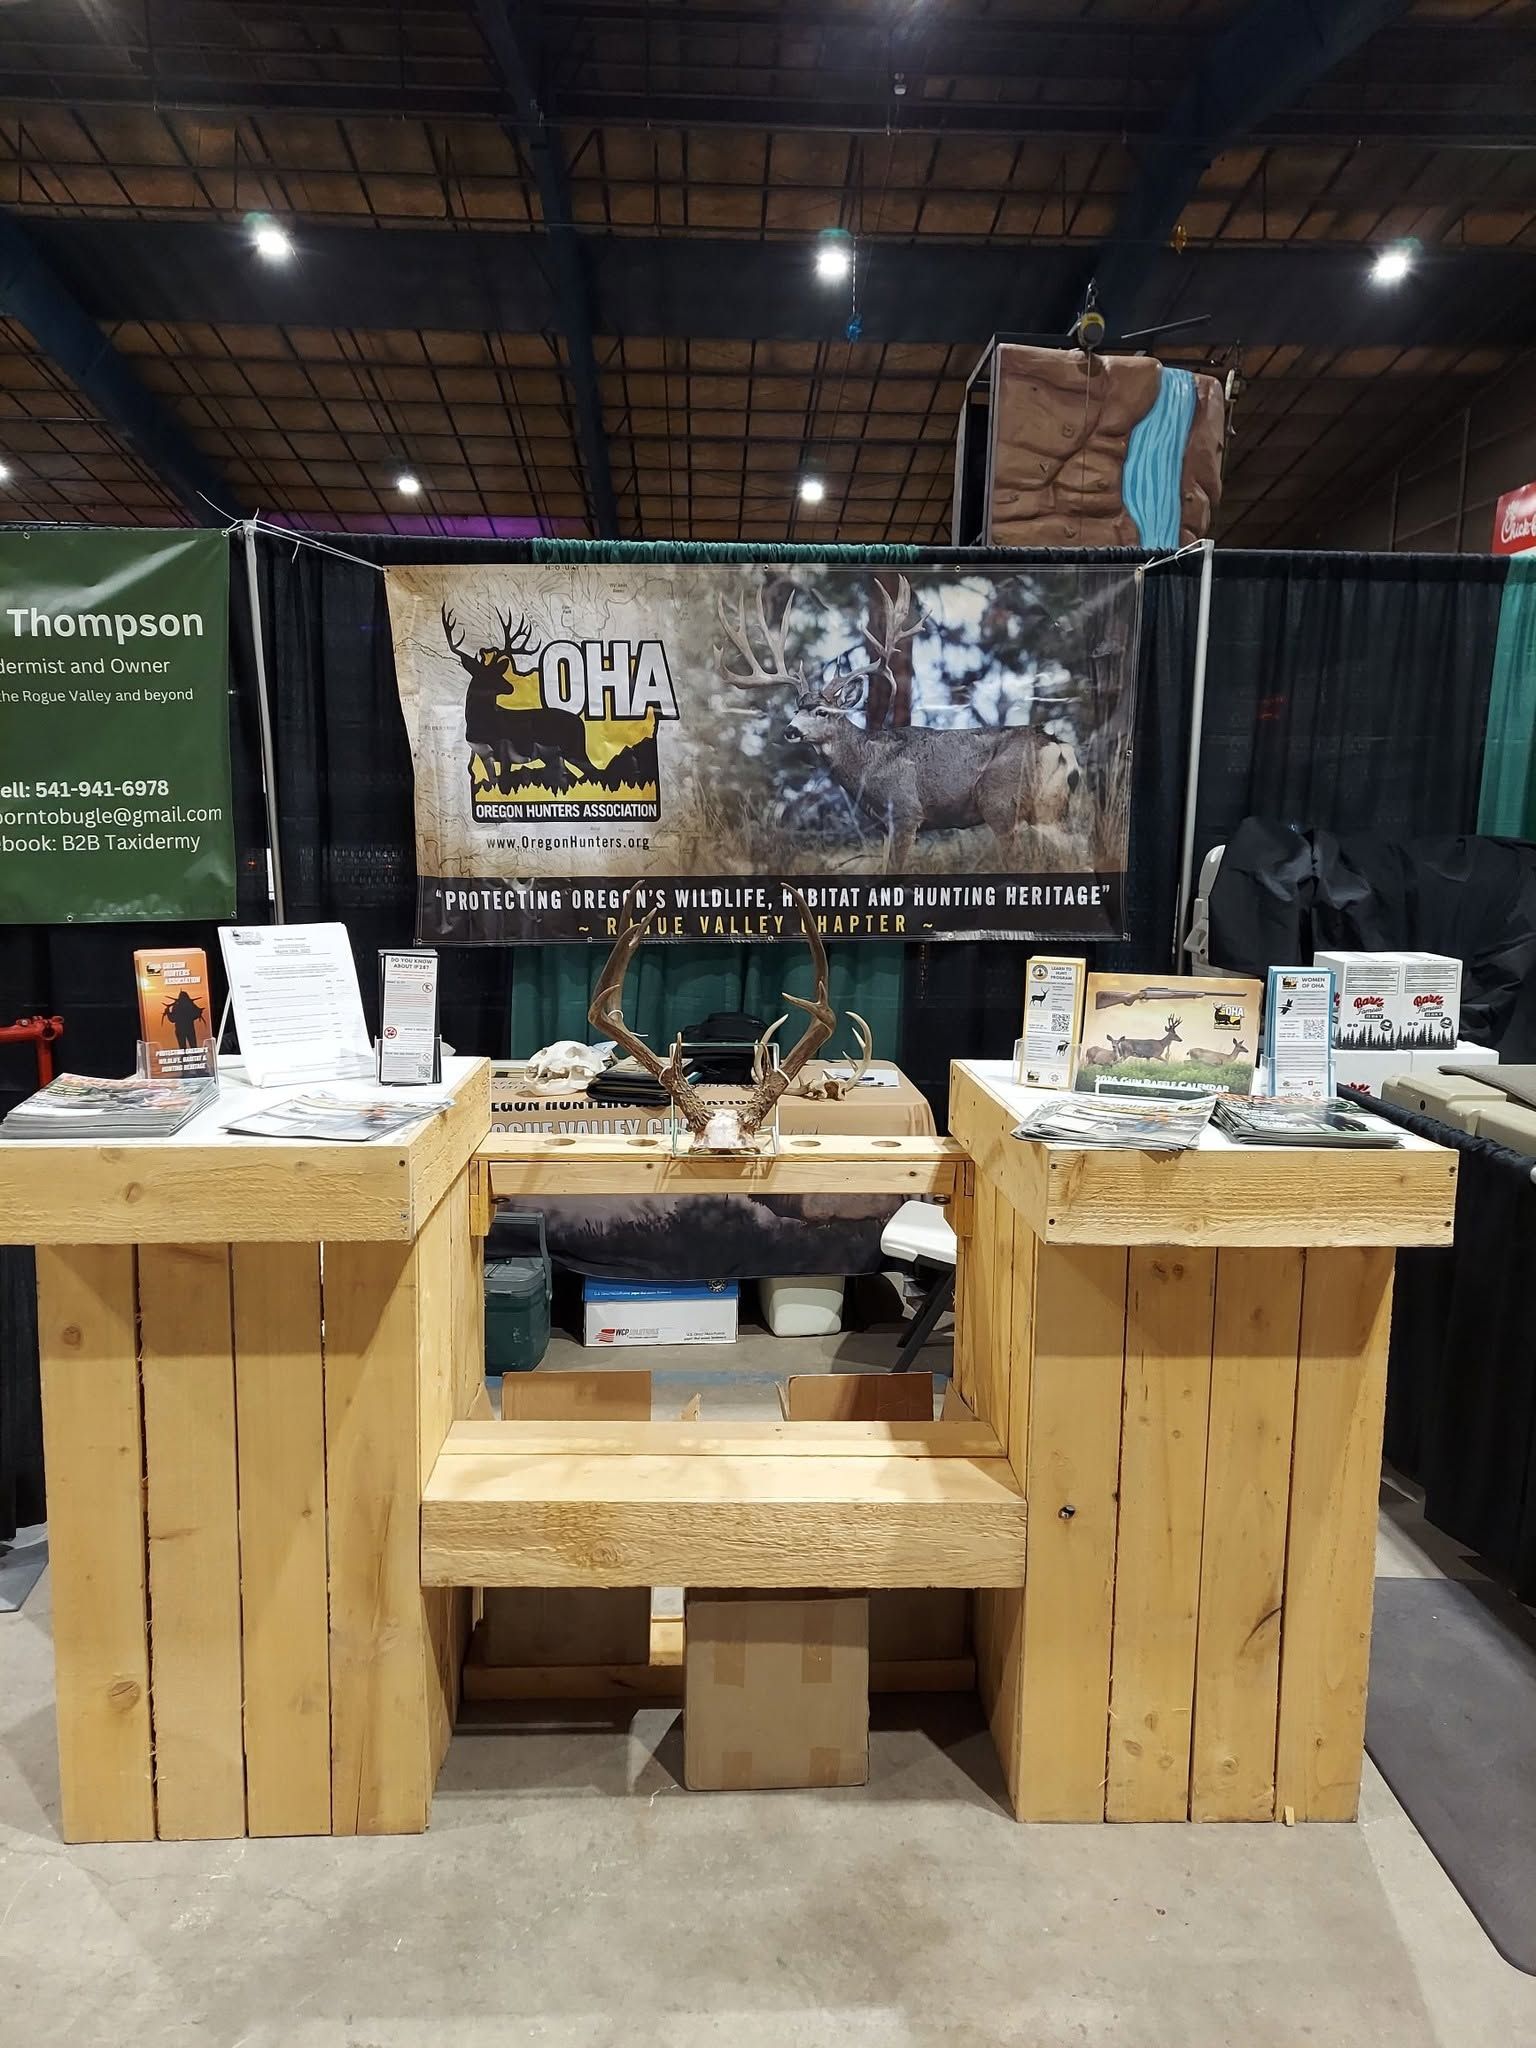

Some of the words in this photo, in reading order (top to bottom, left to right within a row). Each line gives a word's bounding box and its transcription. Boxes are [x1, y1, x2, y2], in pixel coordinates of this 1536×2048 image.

[6, 607, 204, 645] Thompson
[70, 658, 105, 674] and
[110, 657, 170, 673] Owner
[541, 640, 680, 722] OHA
[23, 690, 66, 704] Rogue
[69, 690, 111, 704] Valley
[115, 689, 141, 701] and
[144, 688, 193, 703] beyond
[35, 780, 169, 798] 541-941-6978
[476, 804, 523, 818] OREGON
[526, 804, 580, 818] HUNTERS
[583, 803, 657, 818] ASSOCIATION
[0, 835, 57, 852] book:
[62, 835, 100, 851] B2B
[105, 834, 200, 852] Taxidermy
[486, 835, 650, 851] www.OregonHunters.org
[675, 888, 773, 911] WILDLIFE,
[868, 887, 905, 907] AND
[913, 887, 997, 907] HUNTING
[607, 917, 684, 936] RUE
[700, 915, 784, 934] VALLEY
